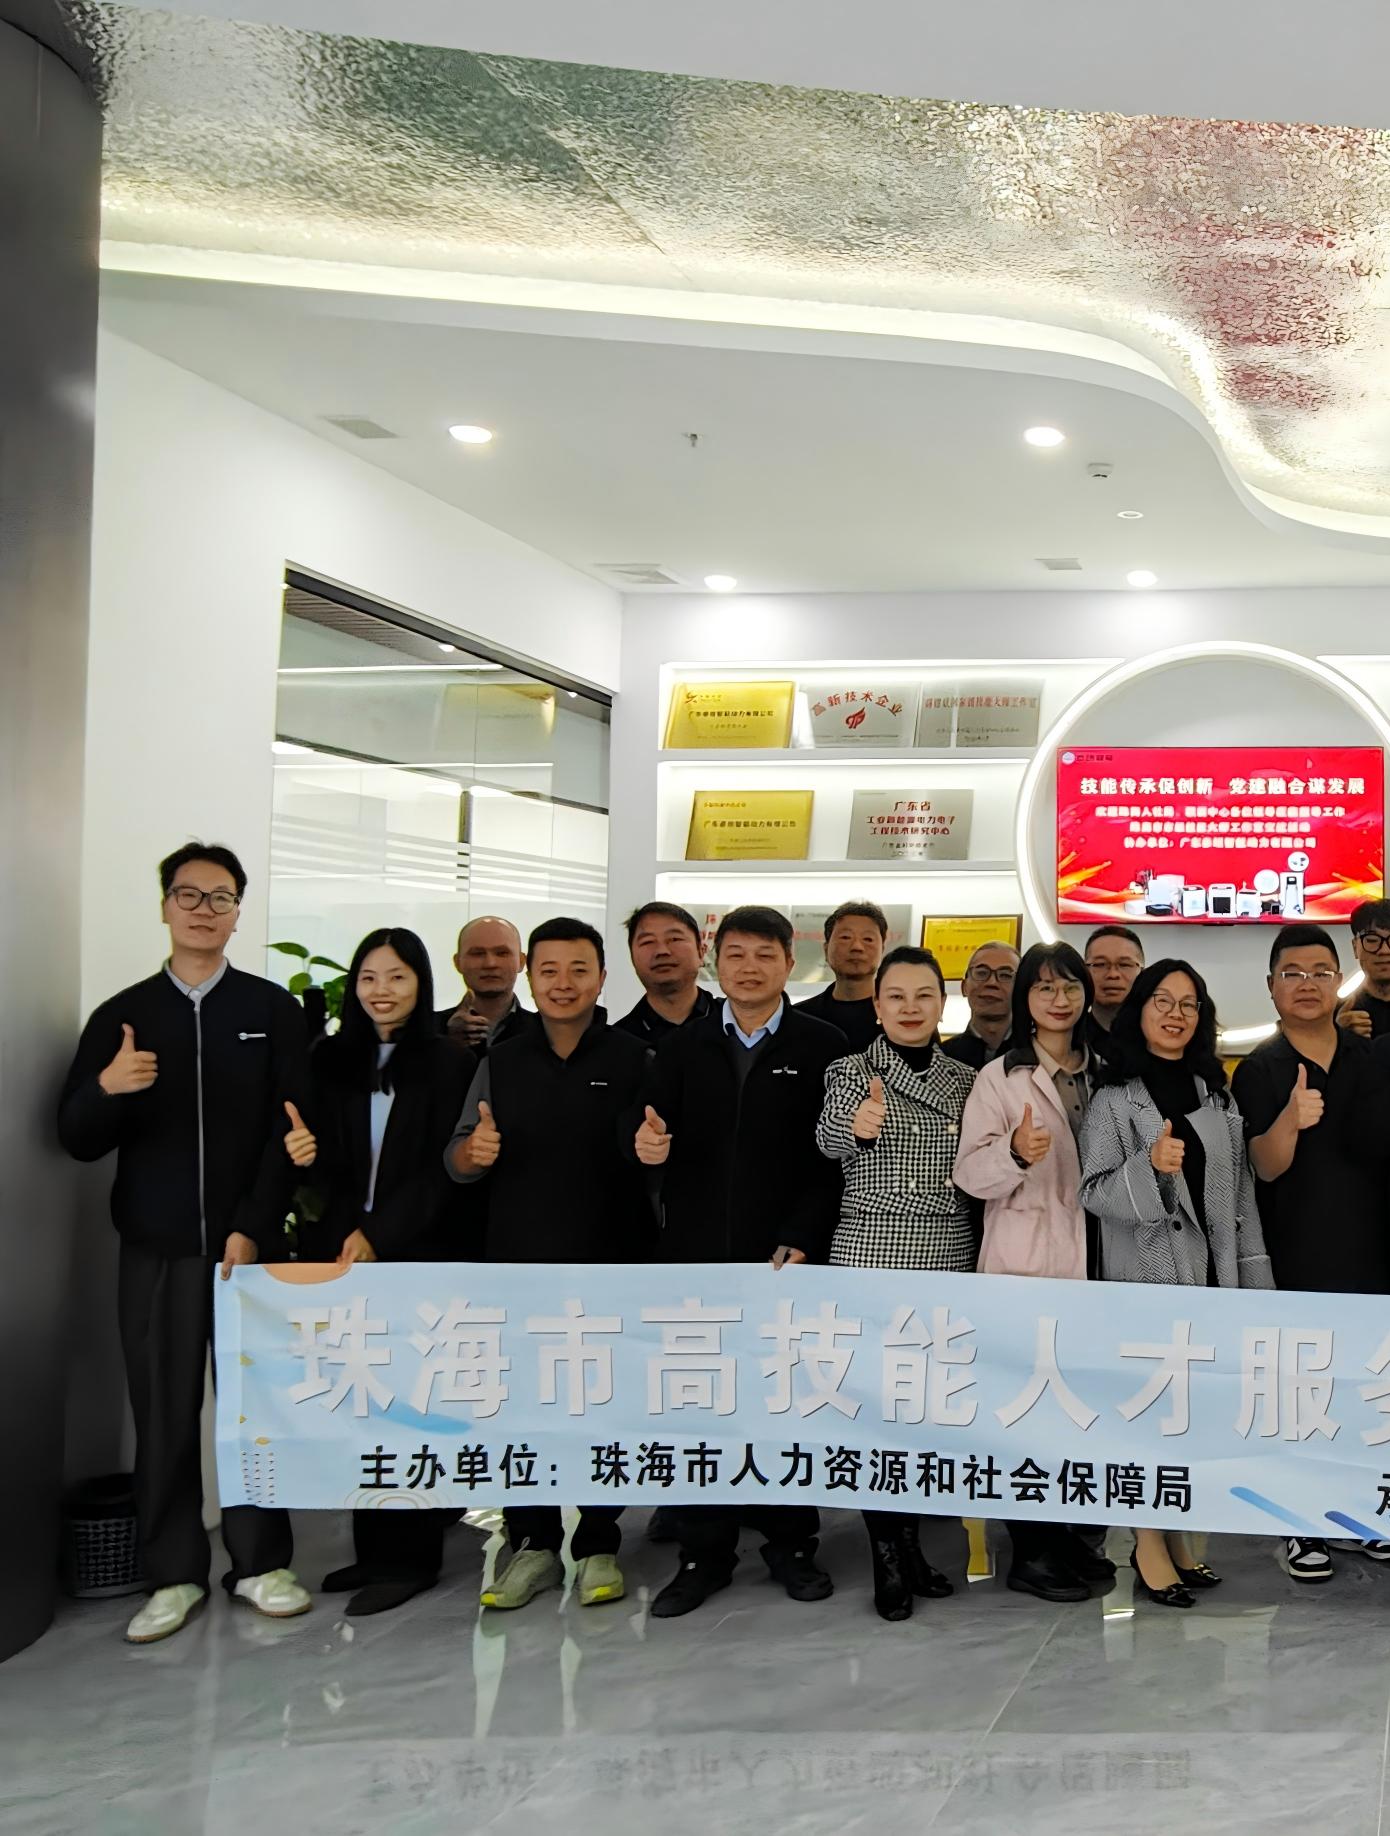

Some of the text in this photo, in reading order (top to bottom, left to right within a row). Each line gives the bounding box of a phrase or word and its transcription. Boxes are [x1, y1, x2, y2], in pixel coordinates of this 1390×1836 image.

[1080, 777, 1366, 795] 技能传承促创新 党建融合谋发展
[893, 800, 932, 812] 广东省
[869, 826, 951, 836] 工程技术研究中心
